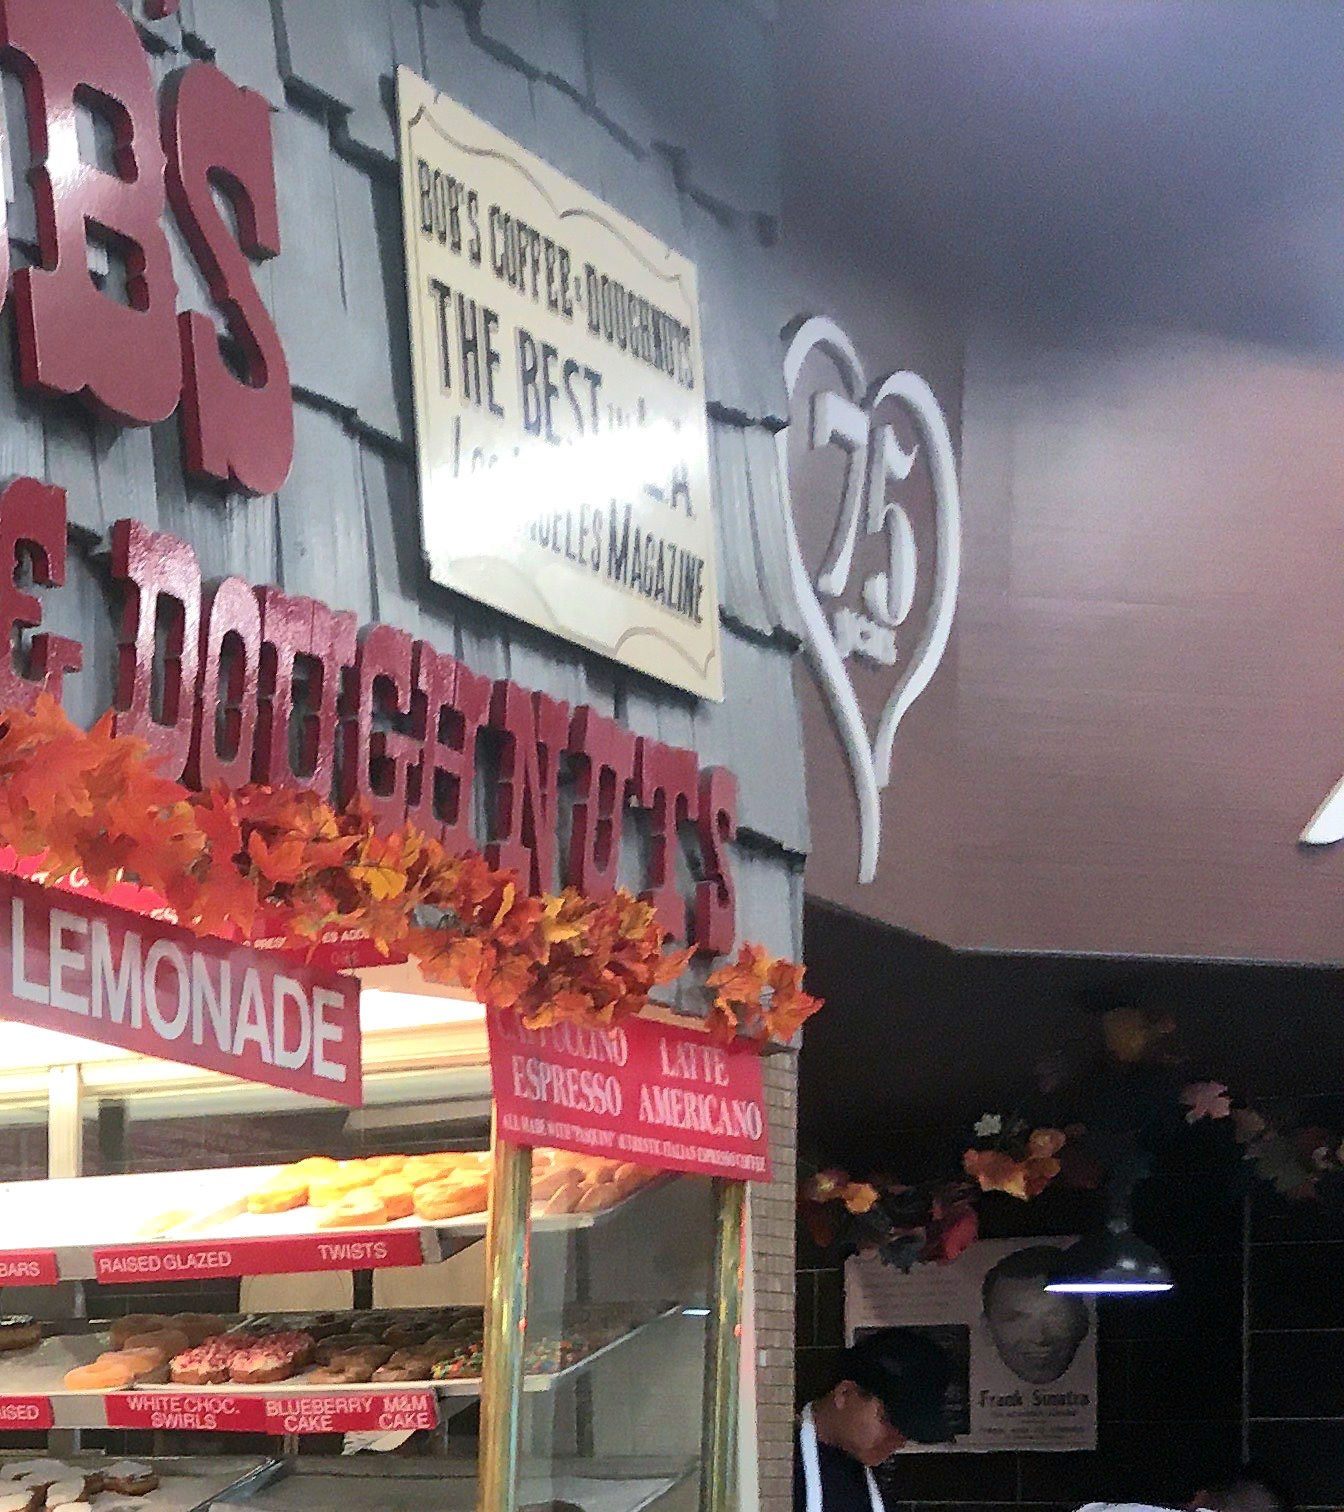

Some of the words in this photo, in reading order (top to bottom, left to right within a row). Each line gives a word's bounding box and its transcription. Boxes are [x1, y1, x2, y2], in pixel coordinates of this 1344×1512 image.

[416, 156, 482, 268] BOB'S
[488, 202, 575, 322] COFFEE
[427, 276, 505, 419] THE
[514, 326, 604, 446] BEST
[608, 496, 706, 624] MAGAZINE
[112, 515, 740, 958] DOUGHNUTS
[11, 896, 348, 1083] LEMONADE
[659, 1036, 730, 1088] LATTE
[511, 1055, 623, 1118] ESPRESSO
[638, 1082, 763, 1142] AMERICANO
[98, 1254, 163, 1276] RAISED
[163, 1250, 233, 1272] GLAZED
[316, 1241, 389, 1263] TWISTS
[126, 1396, 180, 1413] WHITE
[181, 1397, 242, 1416] CHOC.
[264, 1398, 373, 1417] BLUEBERRY
[382, 1395, 428, 1414] M&M
[150, 1412, 218, 1430] SWIRLS
[283, 1413, 335, 1432] CAKE
[377, 1411, 432, 1430] CAKE
